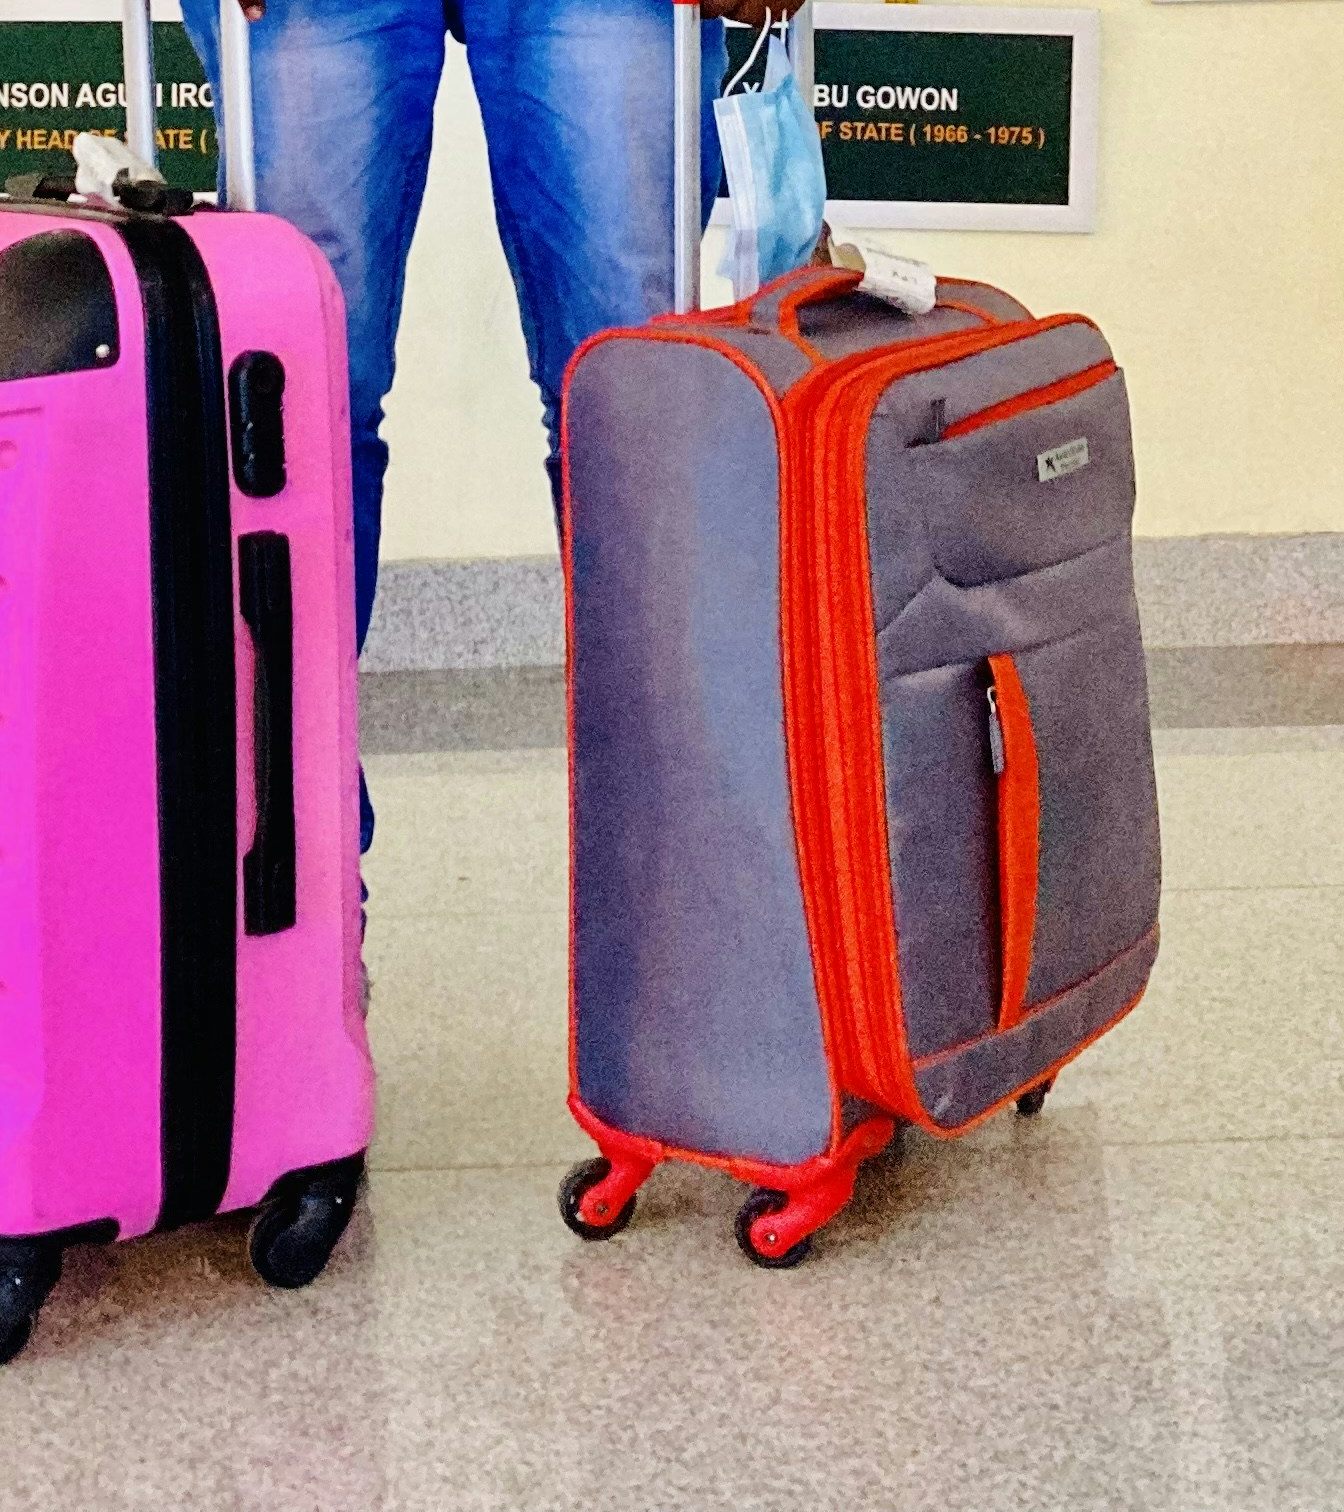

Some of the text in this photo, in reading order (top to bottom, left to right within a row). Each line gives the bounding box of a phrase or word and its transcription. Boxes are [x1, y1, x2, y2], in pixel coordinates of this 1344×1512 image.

[856, 85, 959, 112] GOWON
[16, 129, 80, 152] HEAD
[839, 121, 905, 141] STATE
